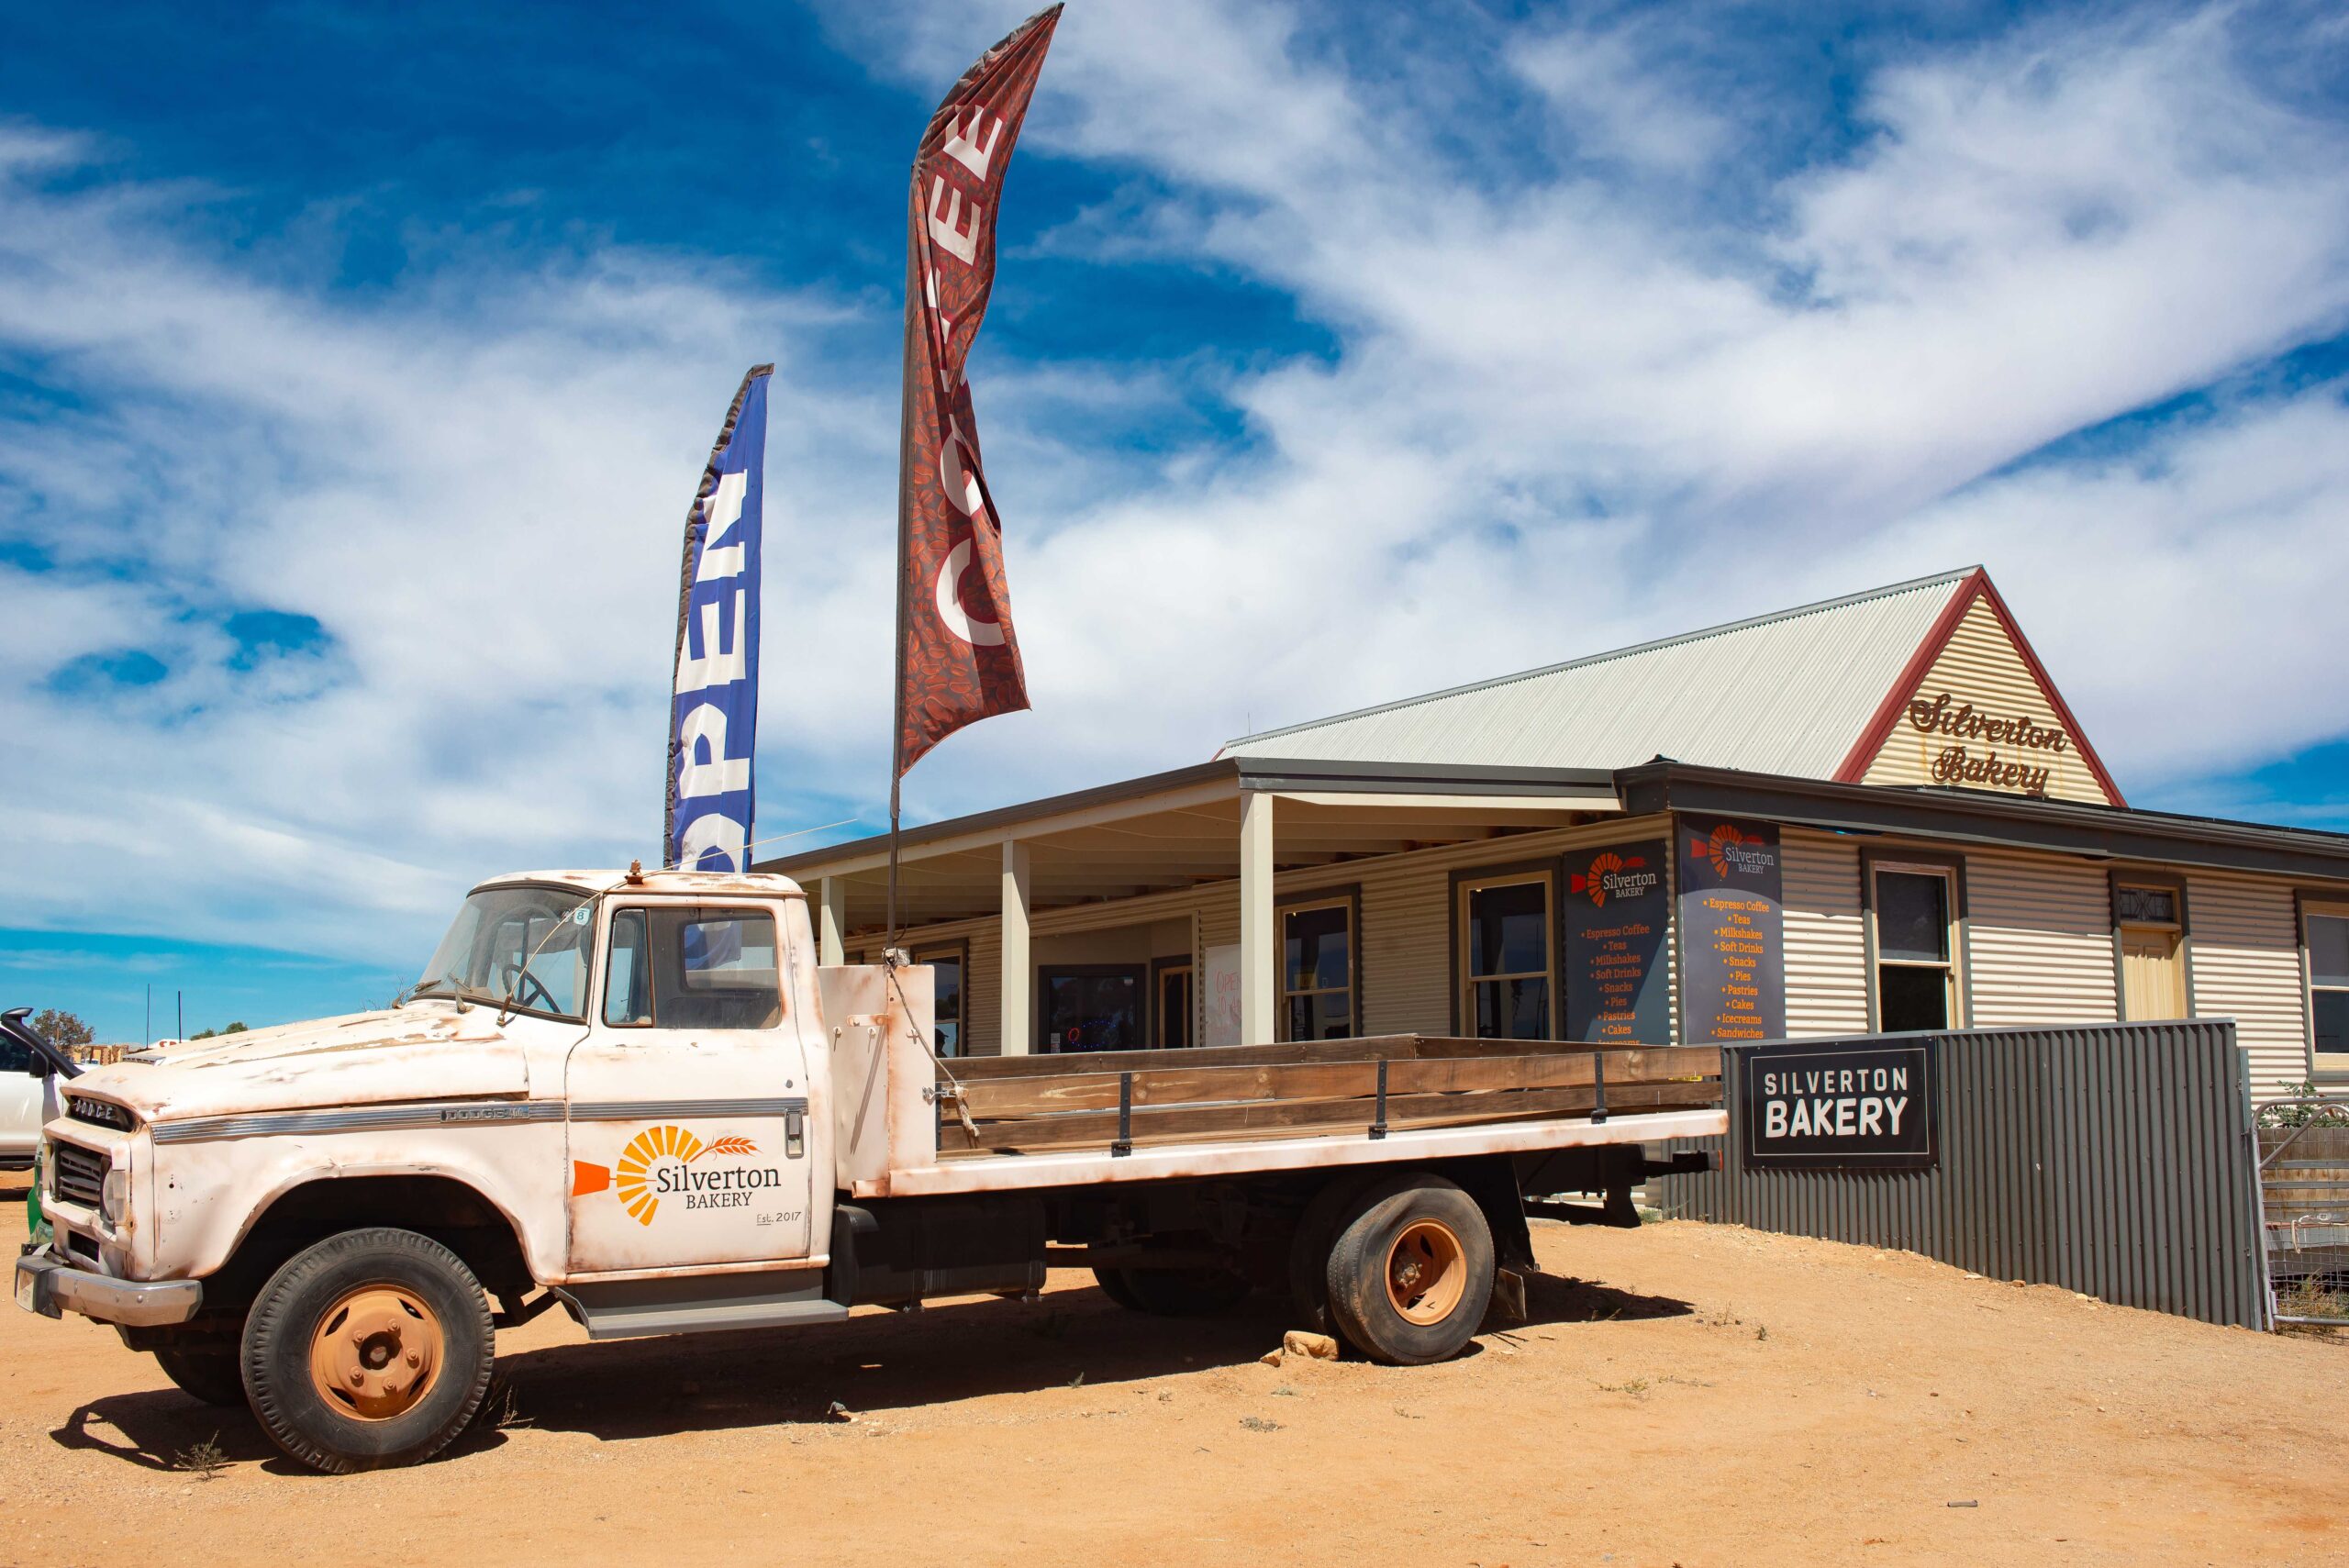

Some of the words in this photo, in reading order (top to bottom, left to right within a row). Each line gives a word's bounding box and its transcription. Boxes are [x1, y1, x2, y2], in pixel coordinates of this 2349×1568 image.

[927, 105, 1007, 646] COEE
[1909, 693, 2067, 752] Silverton
[1932, 746, 2050, 798] Bakery
[1725, 847, 1775, 867] Silverton
[1738, 862, 1764, 874] BAKERY
[1603, 872, 1657, 891] Silverton
[1615, 886, 1644, 898] BAKERY
[1709, 897, 1744, 911] Espresso
[1746, 900, 1770, 913] Coffee
[1732, 915, 1751, 925] Teas
[1586, 929, 1621, 940] Espresso
[1622, 924, 1650, 935] Coffee
[1720, 928, 1763, 940] Milkshakes
[1609, 941, 1627, 951] Teas
[1720, 941, 1738, 951] Soft
[1739, 943, 1764, 954] Drinks
[1596, 954, 1641, 965] Milkshakes
[1729, 957, 1756, 967] Snacks
[1596, 970, 1613, 980] Soft
[1614, 968, 1642, 978] Drinks
[1735, 972, 1751, 981] Pies
[1605, 983, 1633, 993] Snacks
[1727, 985, 1758, 996] Pastries
[1610, 996, 1627, 1006] Pies
[1731, 999, 1754, 1010] Cakes
[1603, 1010, 1636, 1020] Pastries
[1722, 1014, 1762, 1025] Icecreams
[1608, 1024, 1631, 1035] Cakes
[1717, 1027, 1764, 1039] Sandwiches
[1764, 1067, 1909, 1095] SILVERTON
[75, 1099, 116, 1120] DODGE
[1765, 1096, 1909, 1139] BAKERY
[656, 1164, 781, 1193] Silverton
[685, 1191, 753, 1210] BAKERY
[776, 1211, 802, 1222] 2017
